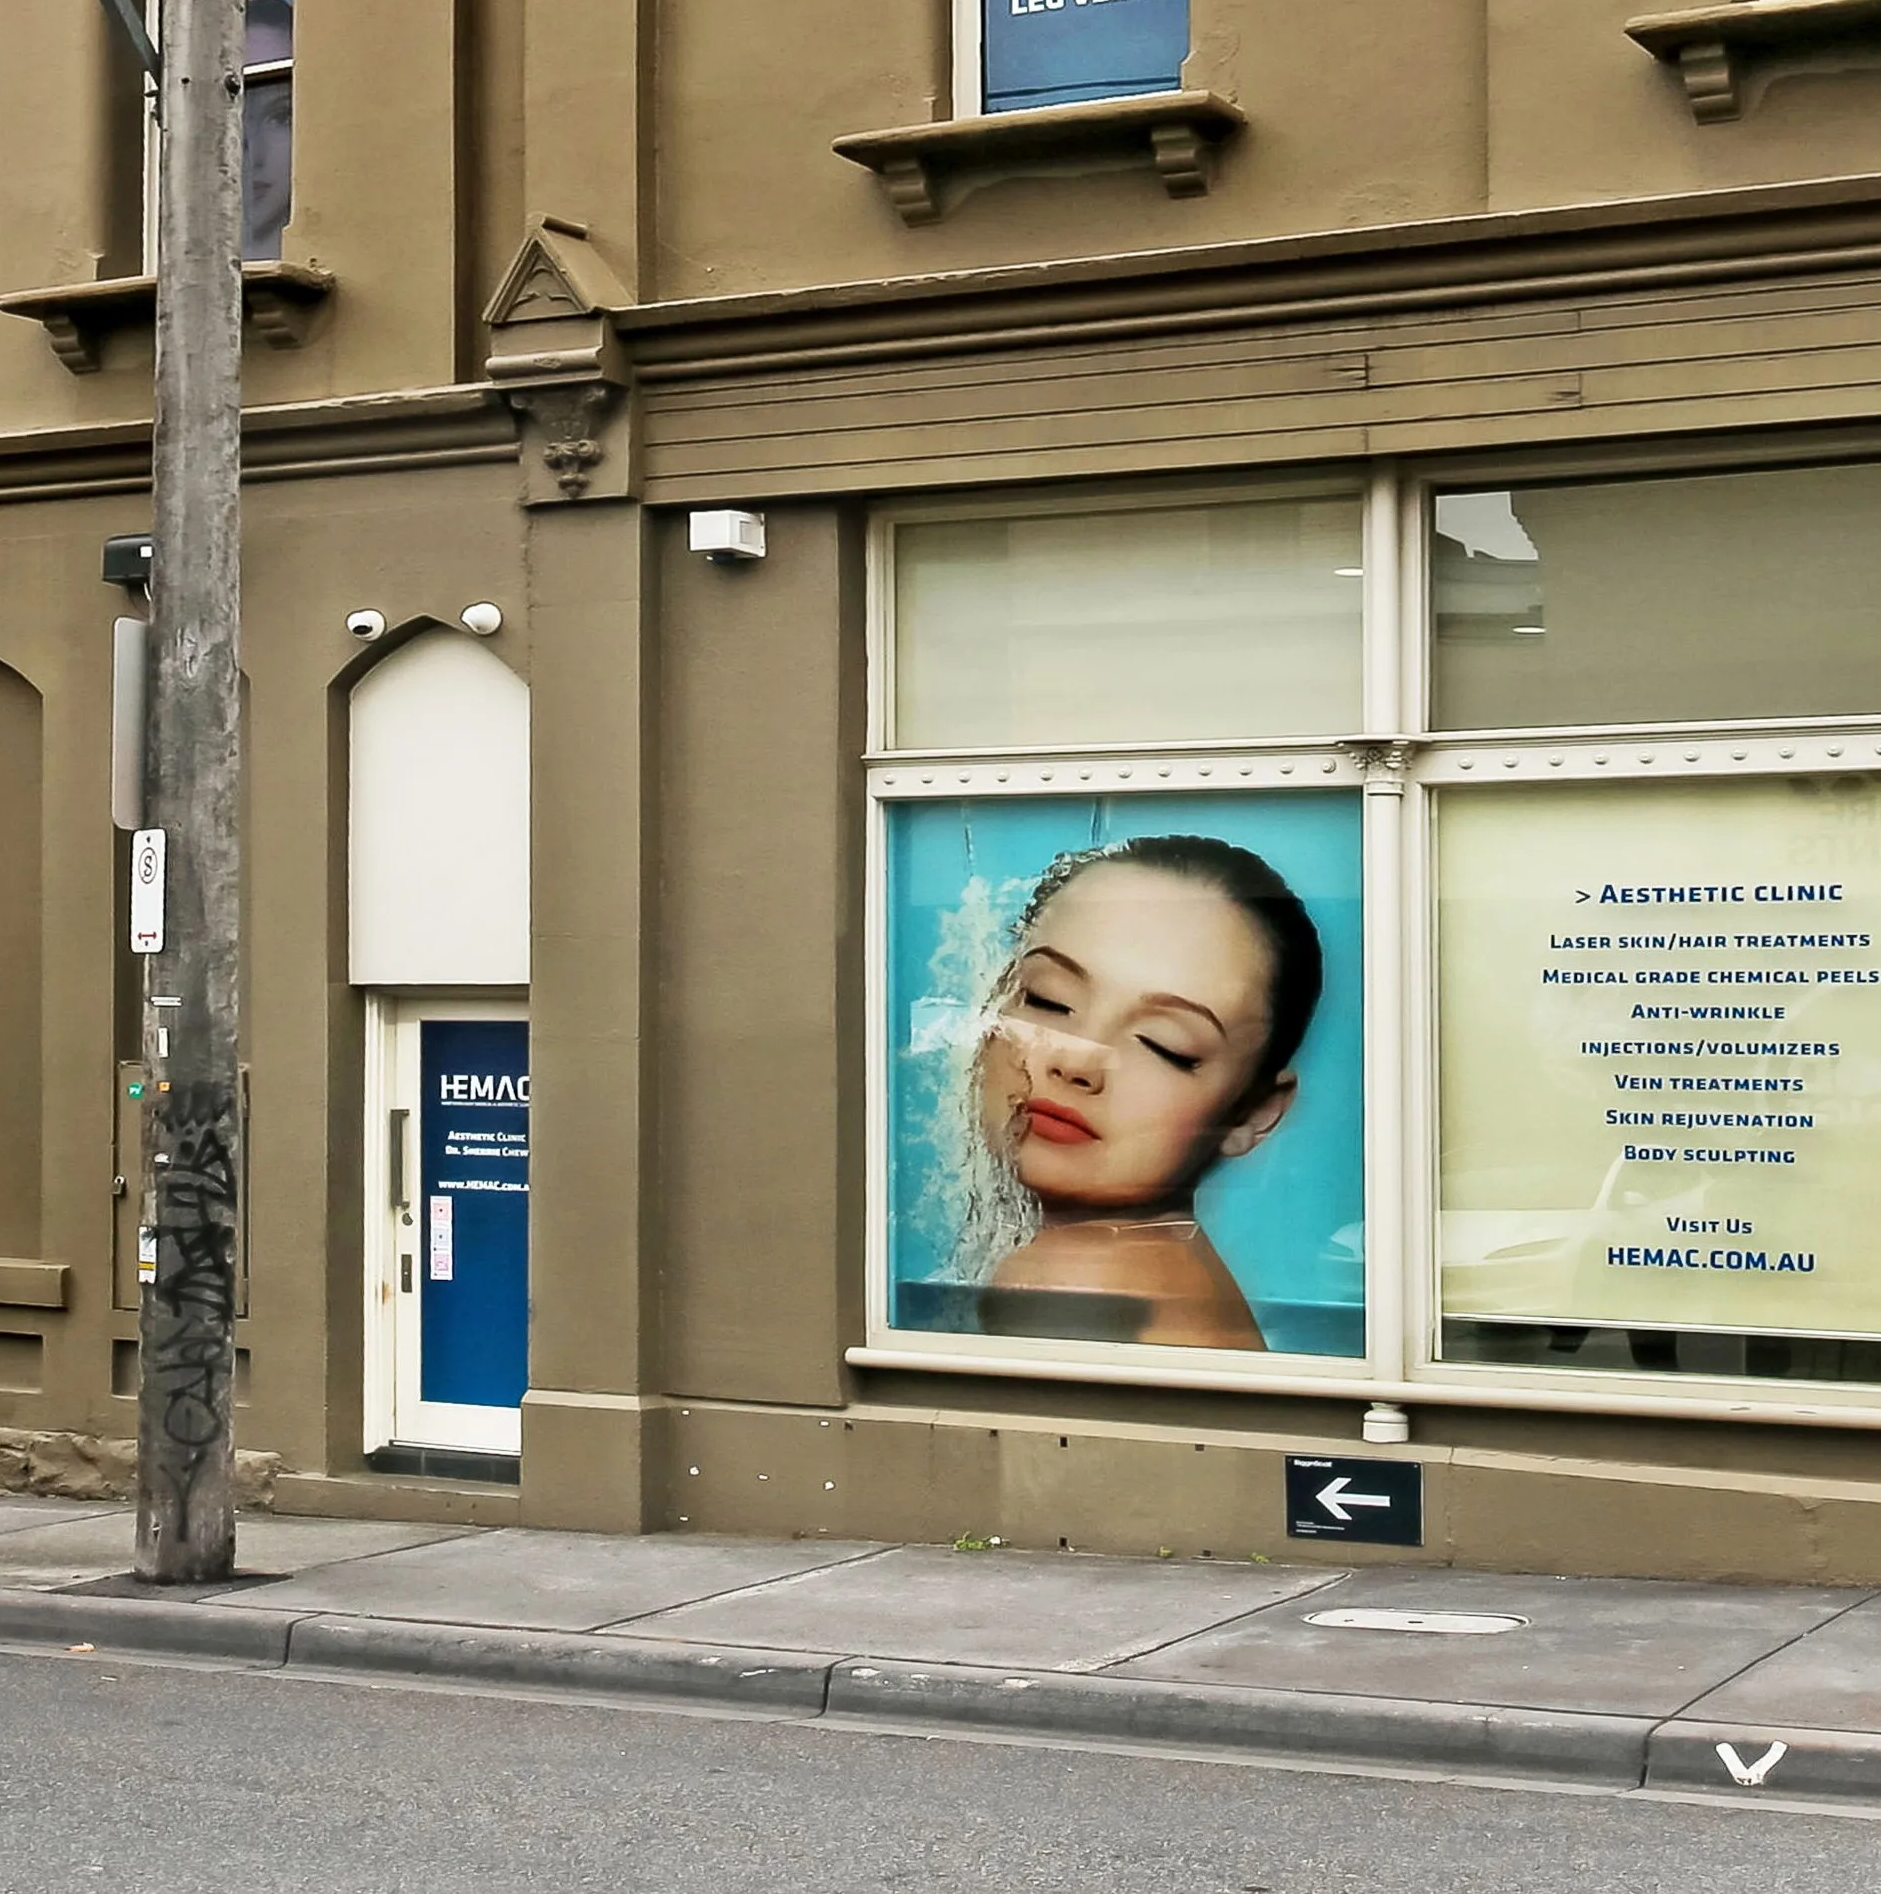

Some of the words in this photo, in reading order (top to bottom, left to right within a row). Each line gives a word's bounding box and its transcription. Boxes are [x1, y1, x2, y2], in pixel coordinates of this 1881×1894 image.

[1599, 884, 1745, 904] AESTHETIC
[1754, 883, 1843, 902] CLINIC
[1550, 935, 1611, 949] LASER
[1618, 934, 1727, 951] SKIN/HAIR
[1734, 934, 1871, 948] TREATMENTS
[1542, 969, 1629, 984] MEDICAL
[1635, 971, 1701, 984] GRADE
[1707, 971, 1809, 983] CHEMICAL
[1817, 970, 1880, 983] PEELS
[1631, 1004, 1785, 1020] ANTI-WRINKLE
[1582, 1039, 1840, 1057] INJECTIONS/VOLUMIZERS
[1614, 1075, 1662, 1090] VEIN
[1670, 1077, 1804, 1092] TREATMENTS
[1606, 1109, 1654, 1125] SKIN
[1662, 1113, 1814, 1129] REJUVENATION
[1624, 1145, 1676, 1160] BODY
[1683, 1149, 1795, 1164] SCULPTING
[1666, 1217, 1720, 1233] VISIT
[1726, 1218, 1753, 1234] US
[1608, 1246, 1815, 1272] HEMAC.COM.AU
